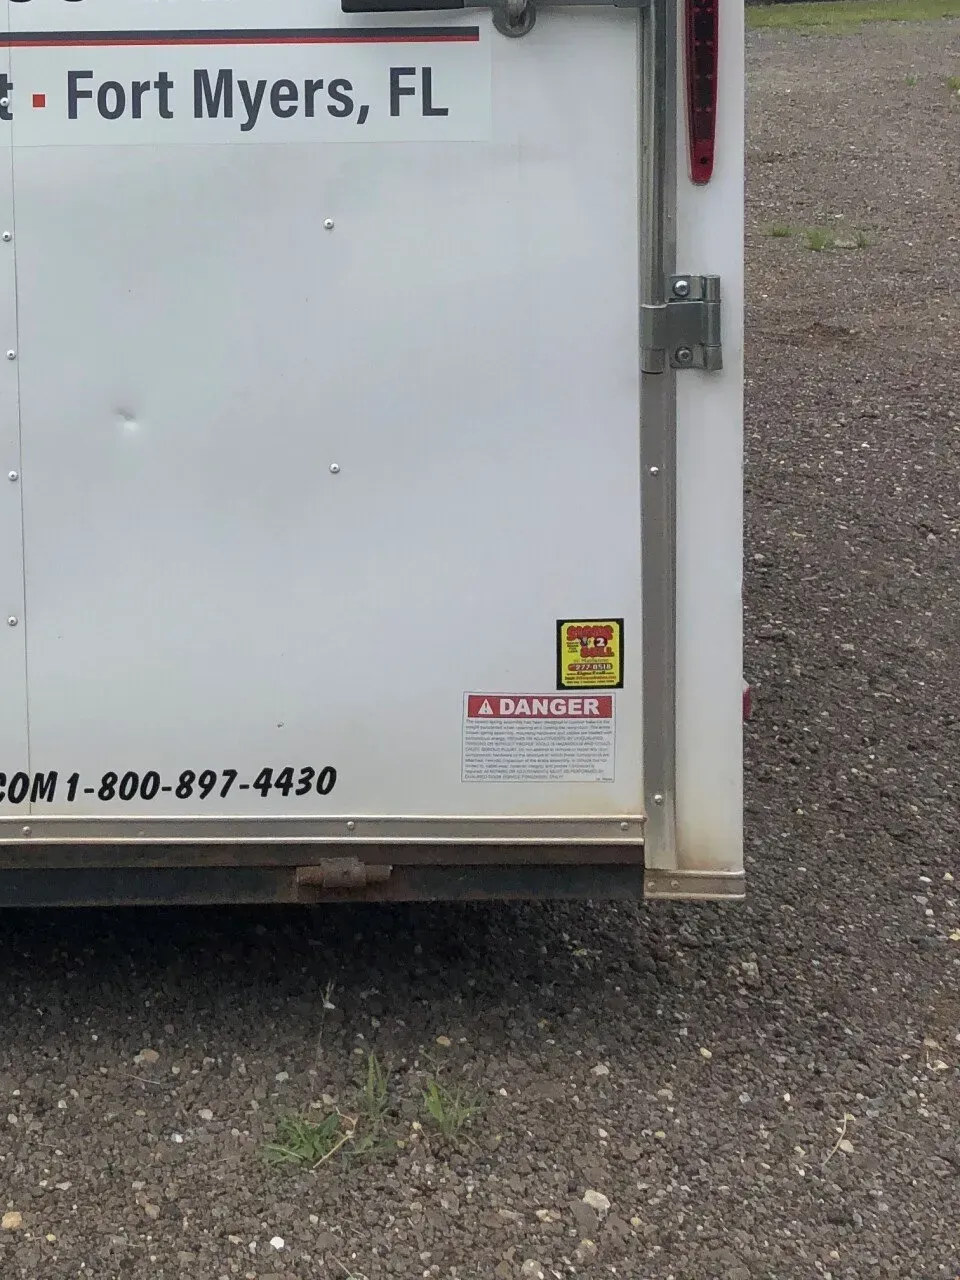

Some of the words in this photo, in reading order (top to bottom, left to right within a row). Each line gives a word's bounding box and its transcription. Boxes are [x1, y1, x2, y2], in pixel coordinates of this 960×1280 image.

[67, 70, 174, 119] Fort
[193, 69, 369, 131] Myers,
[389, 67, 449, 116] FL
[500, 698, 600, 716] DANGER
[66, 766, 337, 802] 1-800-897-4430
